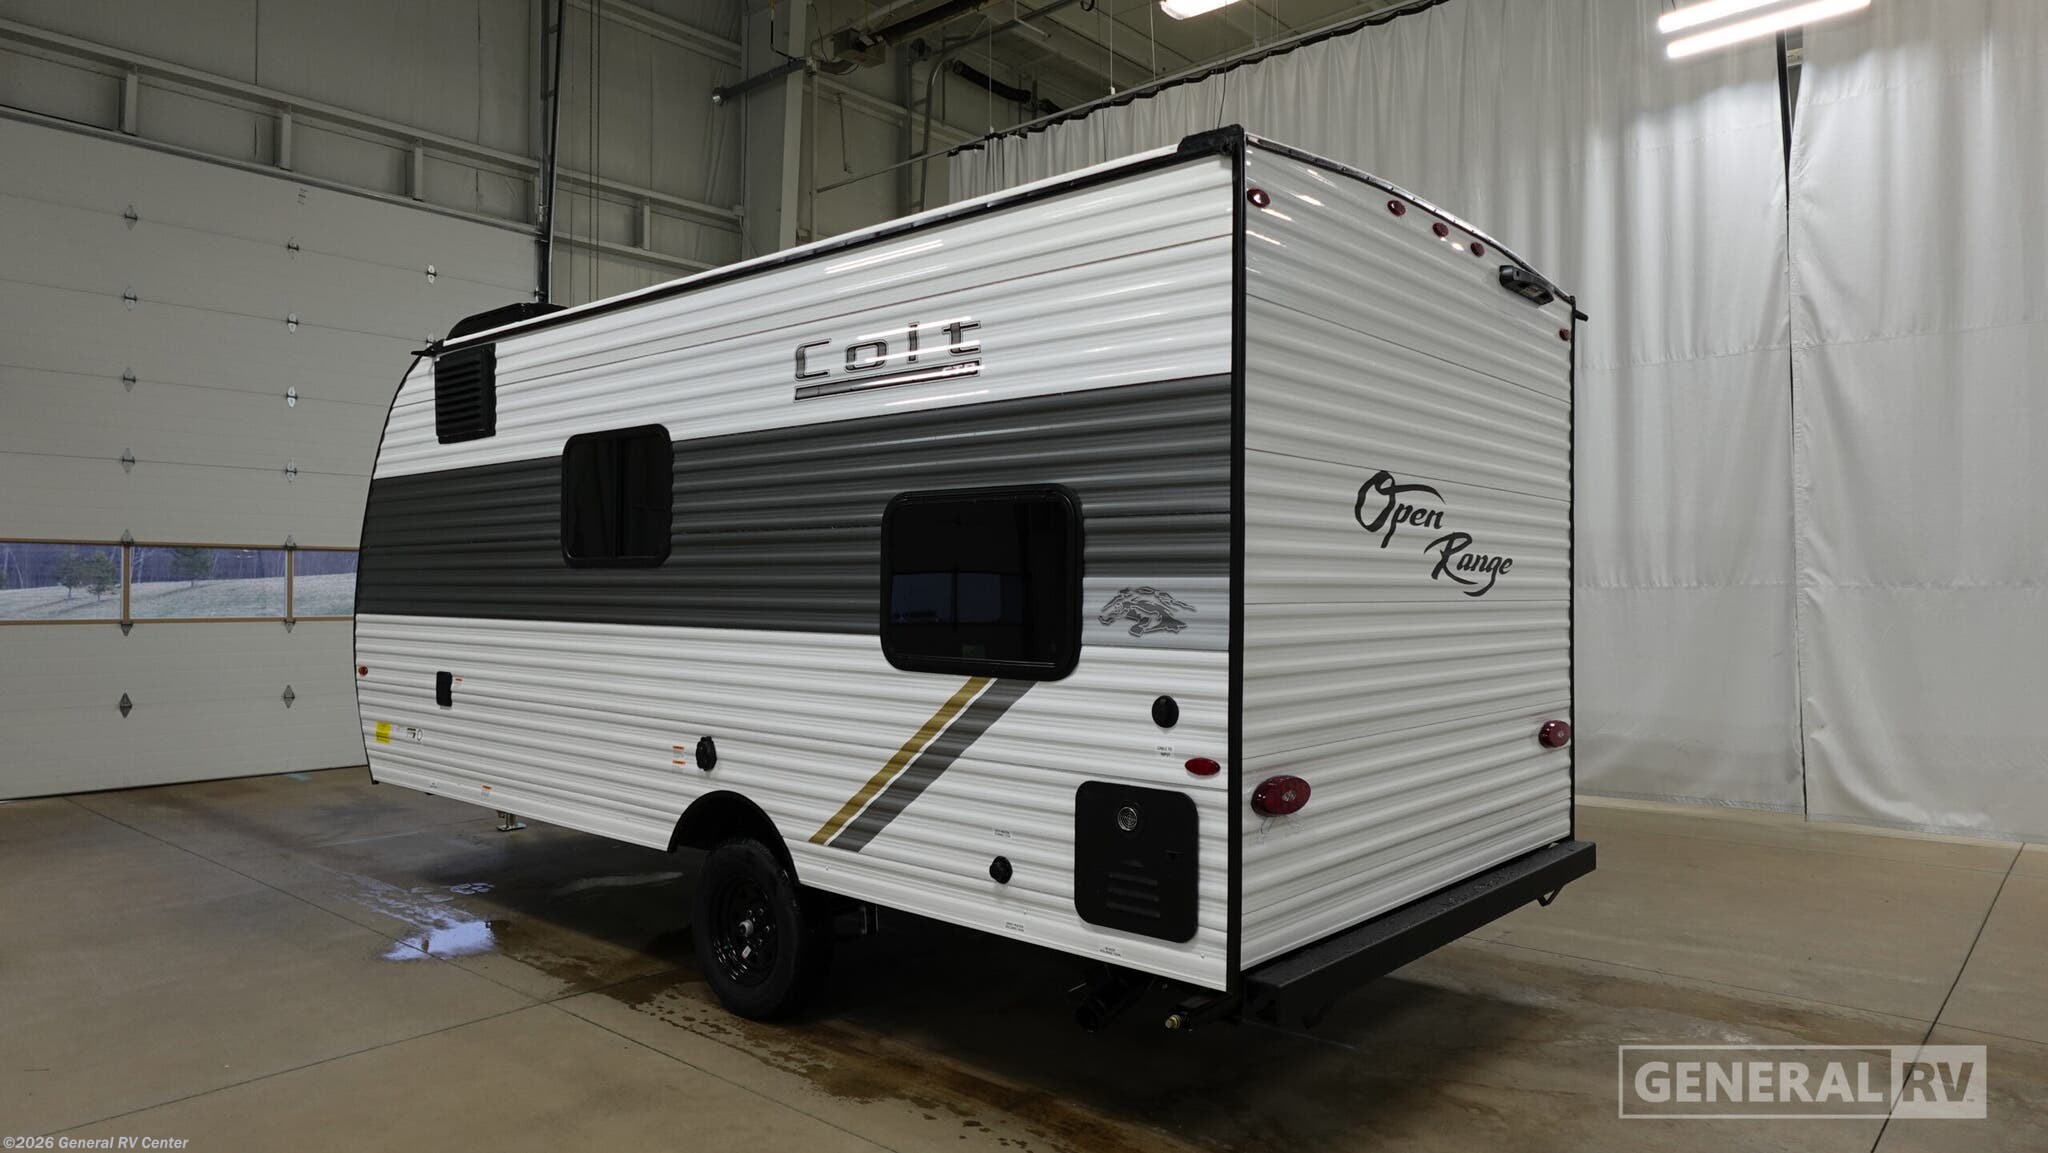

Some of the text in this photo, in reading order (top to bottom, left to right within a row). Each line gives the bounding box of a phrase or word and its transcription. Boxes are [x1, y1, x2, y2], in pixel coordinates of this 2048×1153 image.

[795, 320, 981, 381] Colt
[1355, 470, 1447, 548] Open
[1424, 532, 1513, 597] Range
